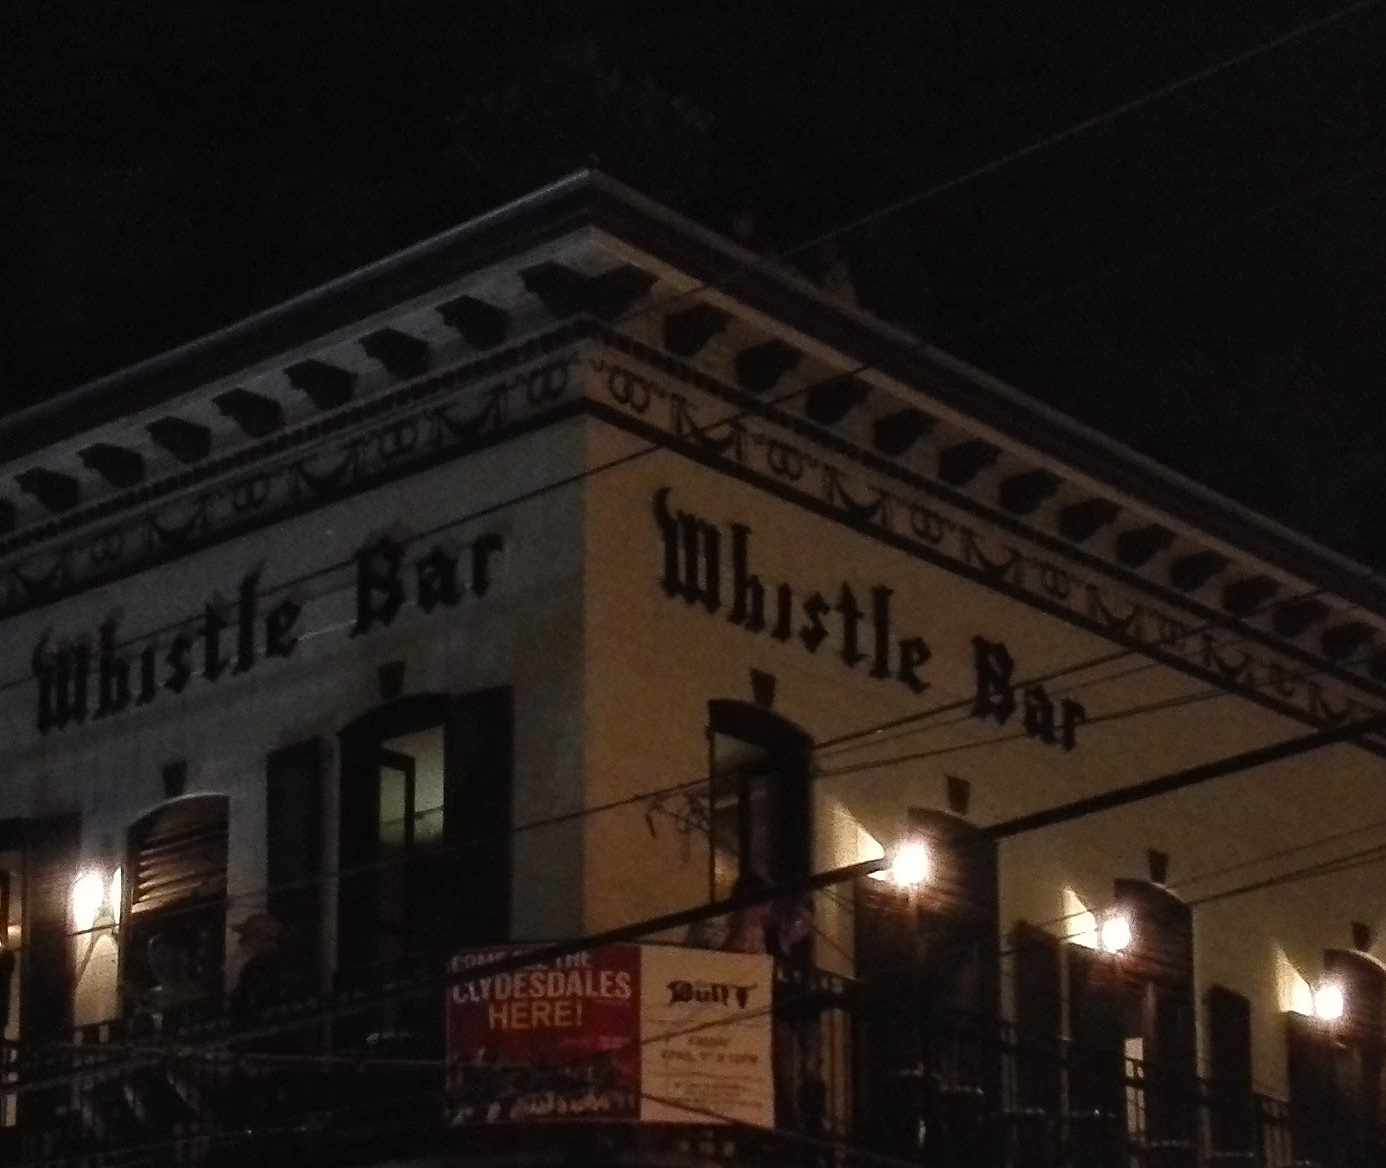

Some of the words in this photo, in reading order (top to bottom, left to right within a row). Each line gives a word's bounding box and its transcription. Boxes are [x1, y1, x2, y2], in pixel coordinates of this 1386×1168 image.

[32, 558, 303, 734] Whistle
[350, 525, 503, 640] Bar
[653, 485, 934, 694] Whistle
[970, 634, 1088, 752] Bar
[452, 969, 632, 1004] CLYDESDALES
[488, 1000, 583, 1031] HERE!
